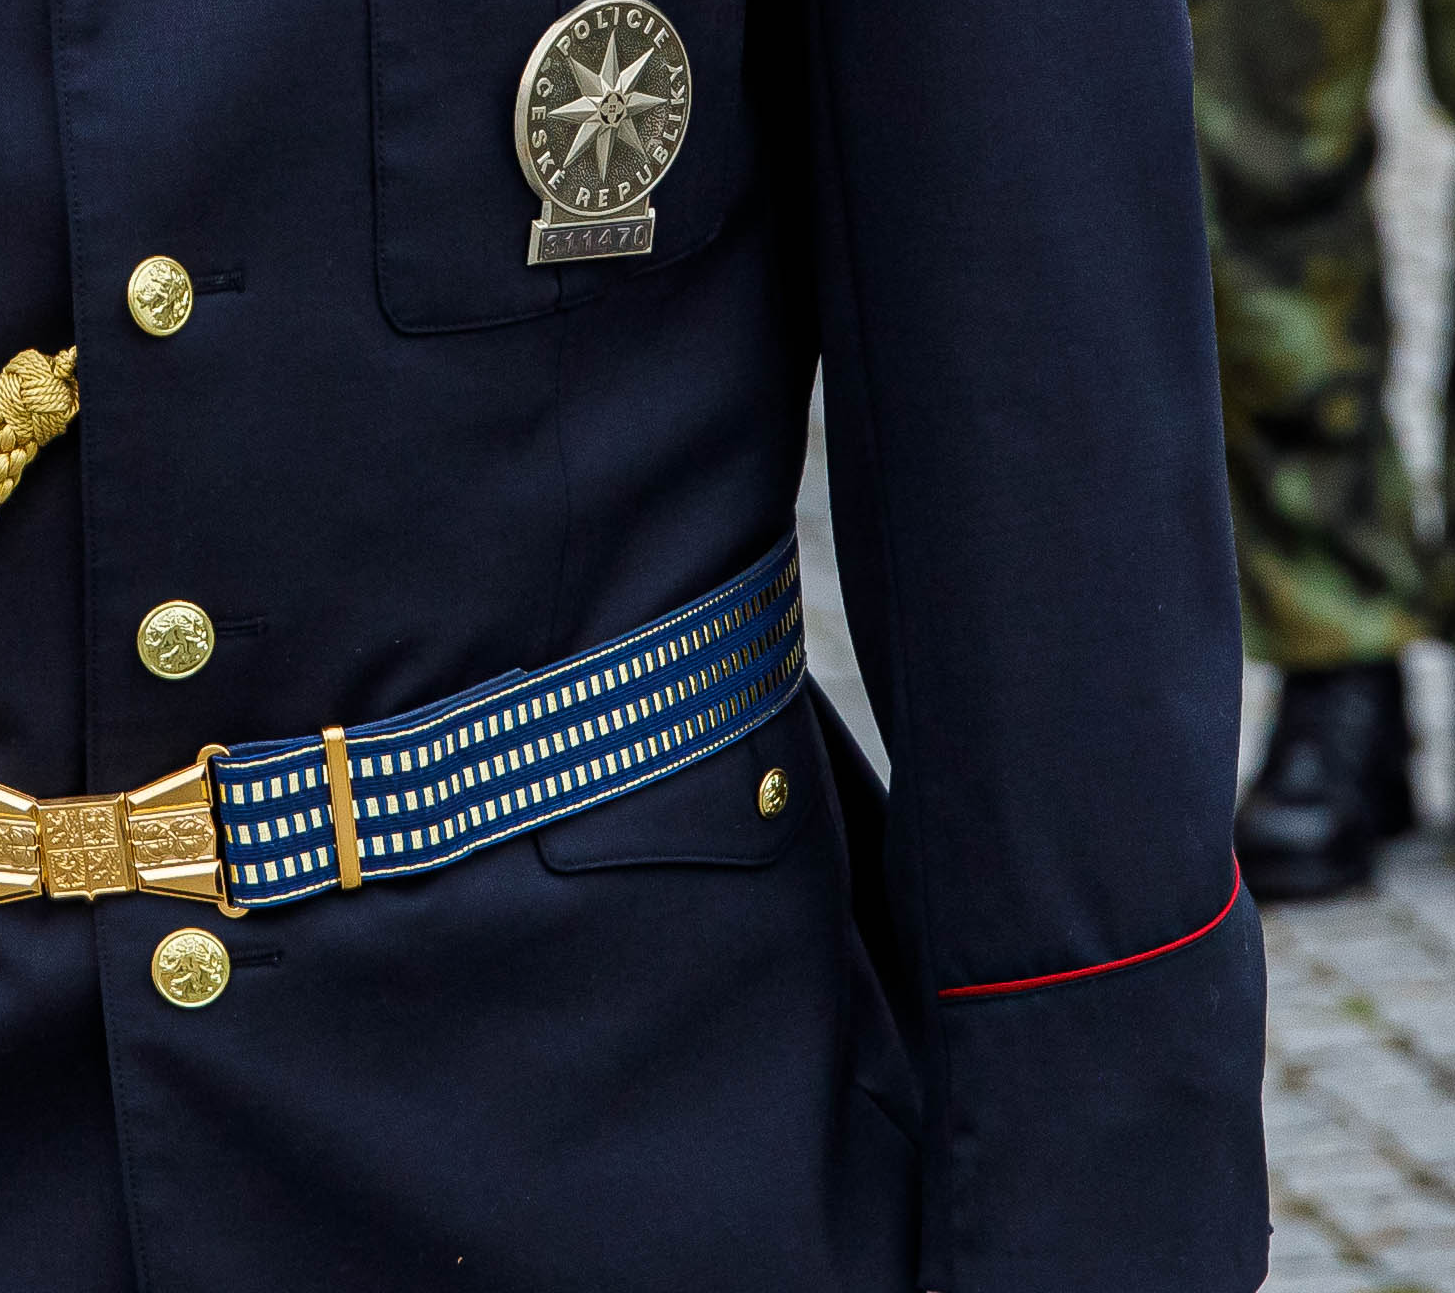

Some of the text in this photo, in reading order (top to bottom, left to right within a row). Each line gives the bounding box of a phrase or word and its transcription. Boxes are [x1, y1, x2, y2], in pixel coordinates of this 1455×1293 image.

[556, 5, 671, 56] POLICIE
[575, 62, 687, 208] REPUBLIKY
[543, 224, 649, 257] 311470
